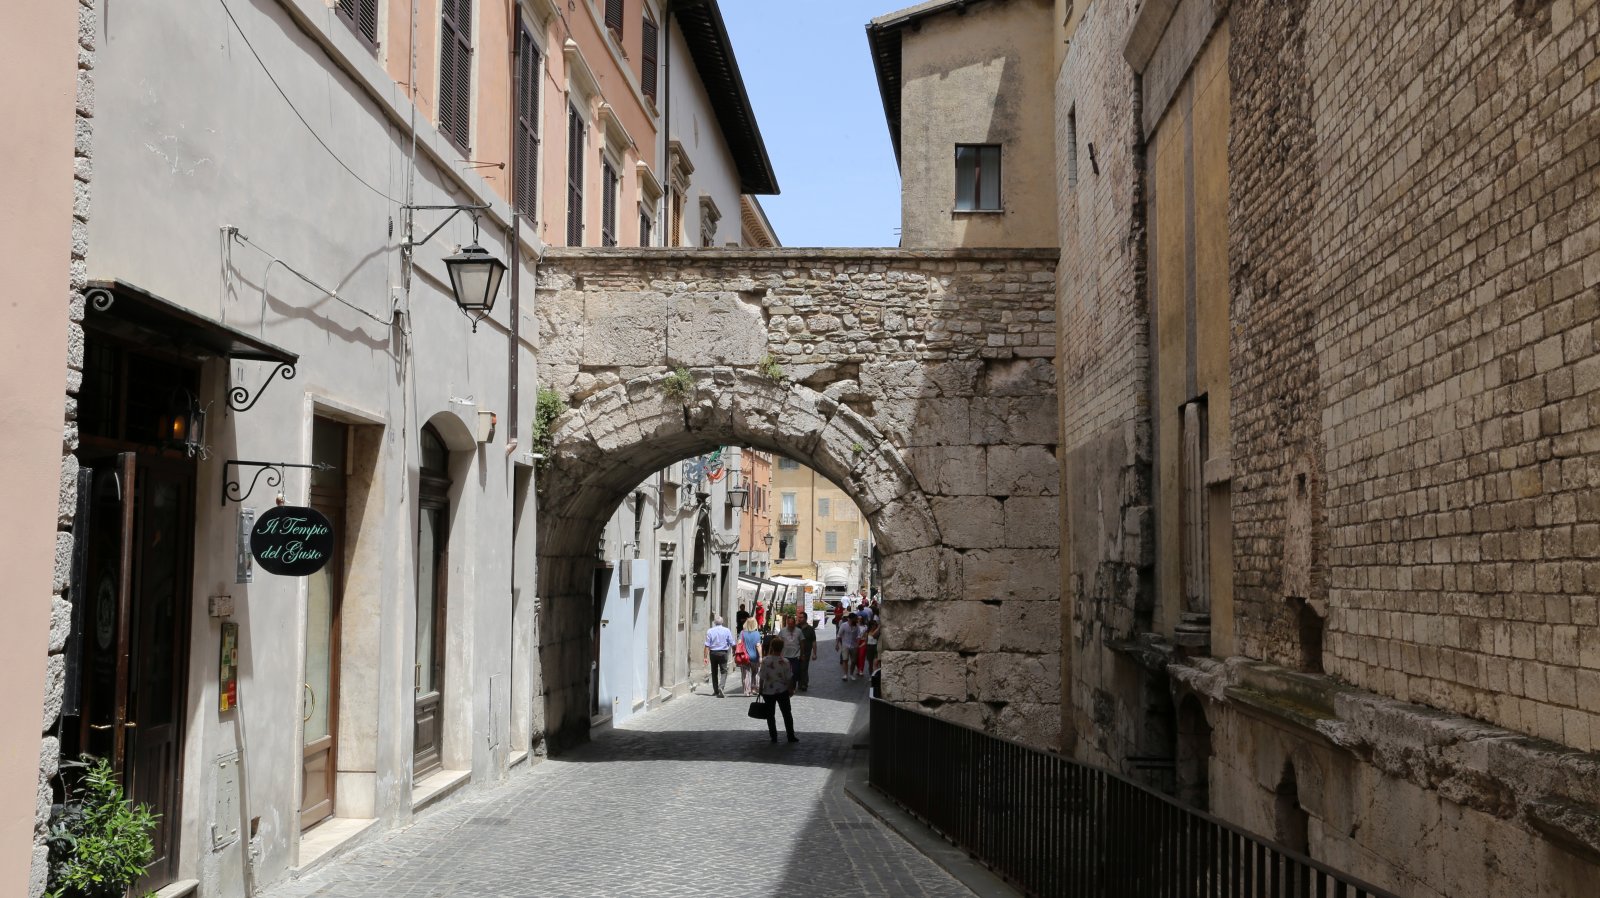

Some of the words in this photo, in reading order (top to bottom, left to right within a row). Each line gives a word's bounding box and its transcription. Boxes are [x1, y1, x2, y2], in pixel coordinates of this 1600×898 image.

[257, 517, 280, 534] Il
[280, 517, 328, 540] Tempio
[261, 546, 282, 559] del
[282, 540, 322, 564] Gusto
